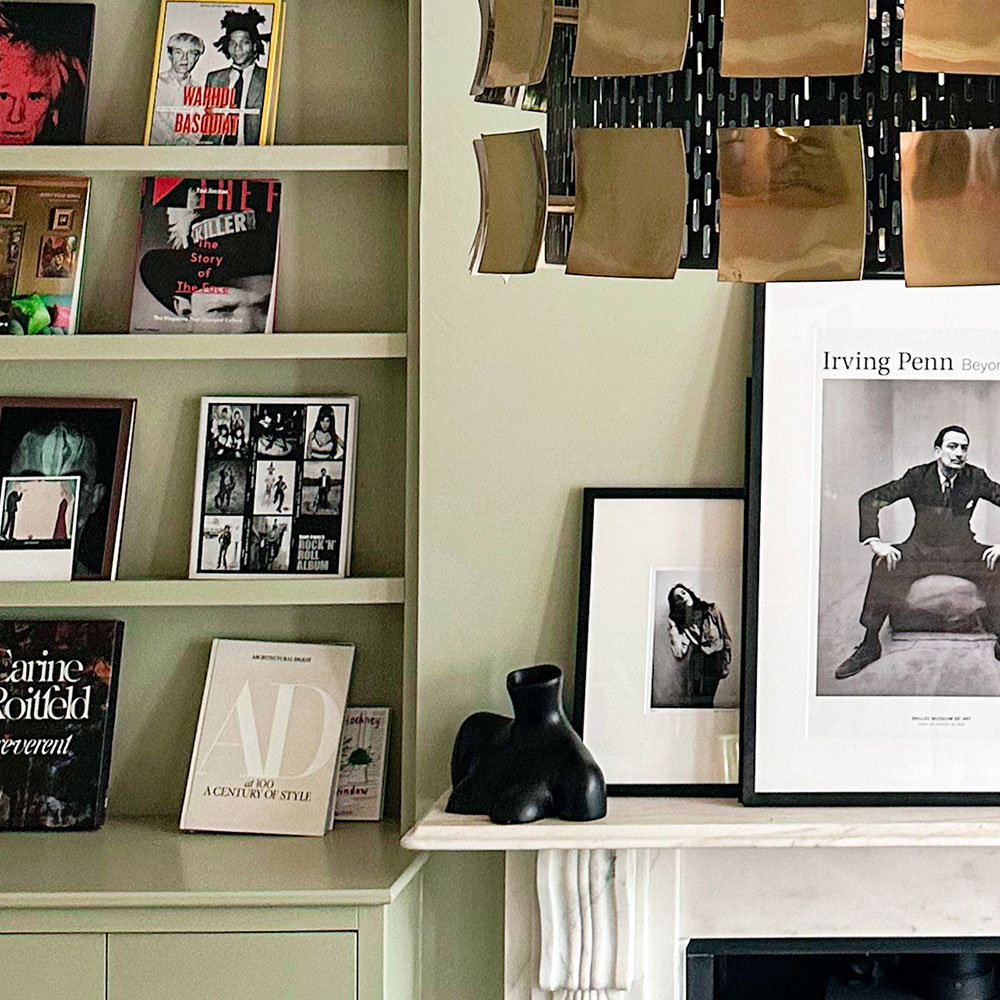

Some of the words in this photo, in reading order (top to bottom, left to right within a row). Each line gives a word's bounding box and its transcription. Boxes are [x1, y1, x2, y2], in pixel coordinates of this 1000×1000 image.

[183, 85, 236, 109] WARHOL
[173, 112, 240, 137] BASQUIAT
[197, 238, 219, 250] The
[190, 252, 223, 267] Story
[197, 267, 212, 279] of
[175, 281, 198, 294] The
[822, 351, 892, 376] Irving
[897, 352, 955, 371] Penn
[196, 679, 344, 779] AD
[0, 733, 73, 756] everent
[256, 778, 275, 788] 100
[203, 786, 211, 796] A
[212, 786, 262, 799] CENTURY
[264, 789, 280, 800] OF
[280, 790, 313, 802] STYLE
